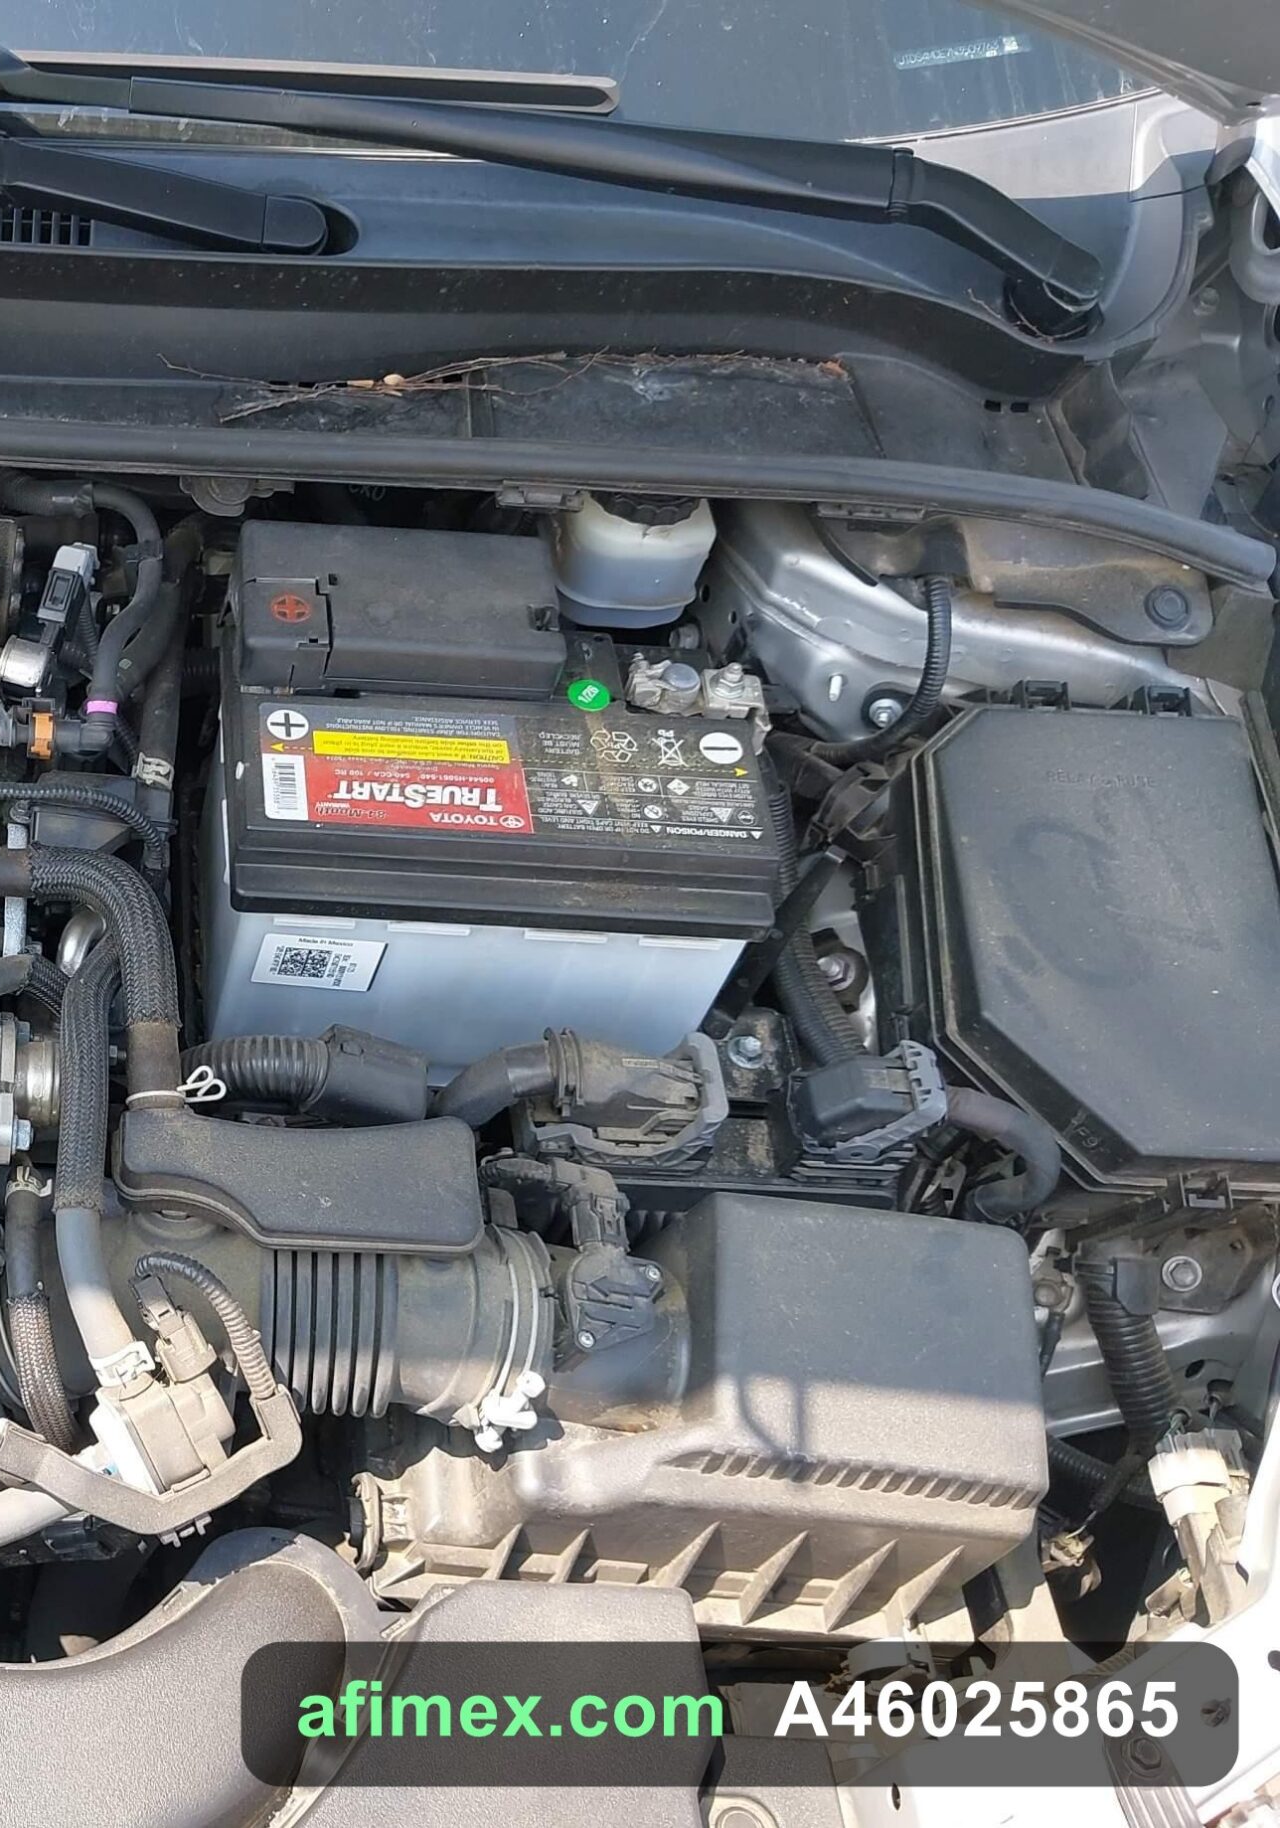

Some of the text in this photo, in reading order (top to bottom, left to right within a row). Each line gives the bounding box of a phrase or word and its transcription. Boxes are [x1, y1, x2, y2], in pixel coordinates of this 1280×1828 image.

[657, 729, 674, 737] Pb
[556, 740, 580, 748] MUST
[544, 747, 581, 755] BATTERY
[315, 806, 385, 818] 84-Month
[429, 812, 498, 826] TOYOTA
[666, 827, 748, 838] DANGER/POISON
